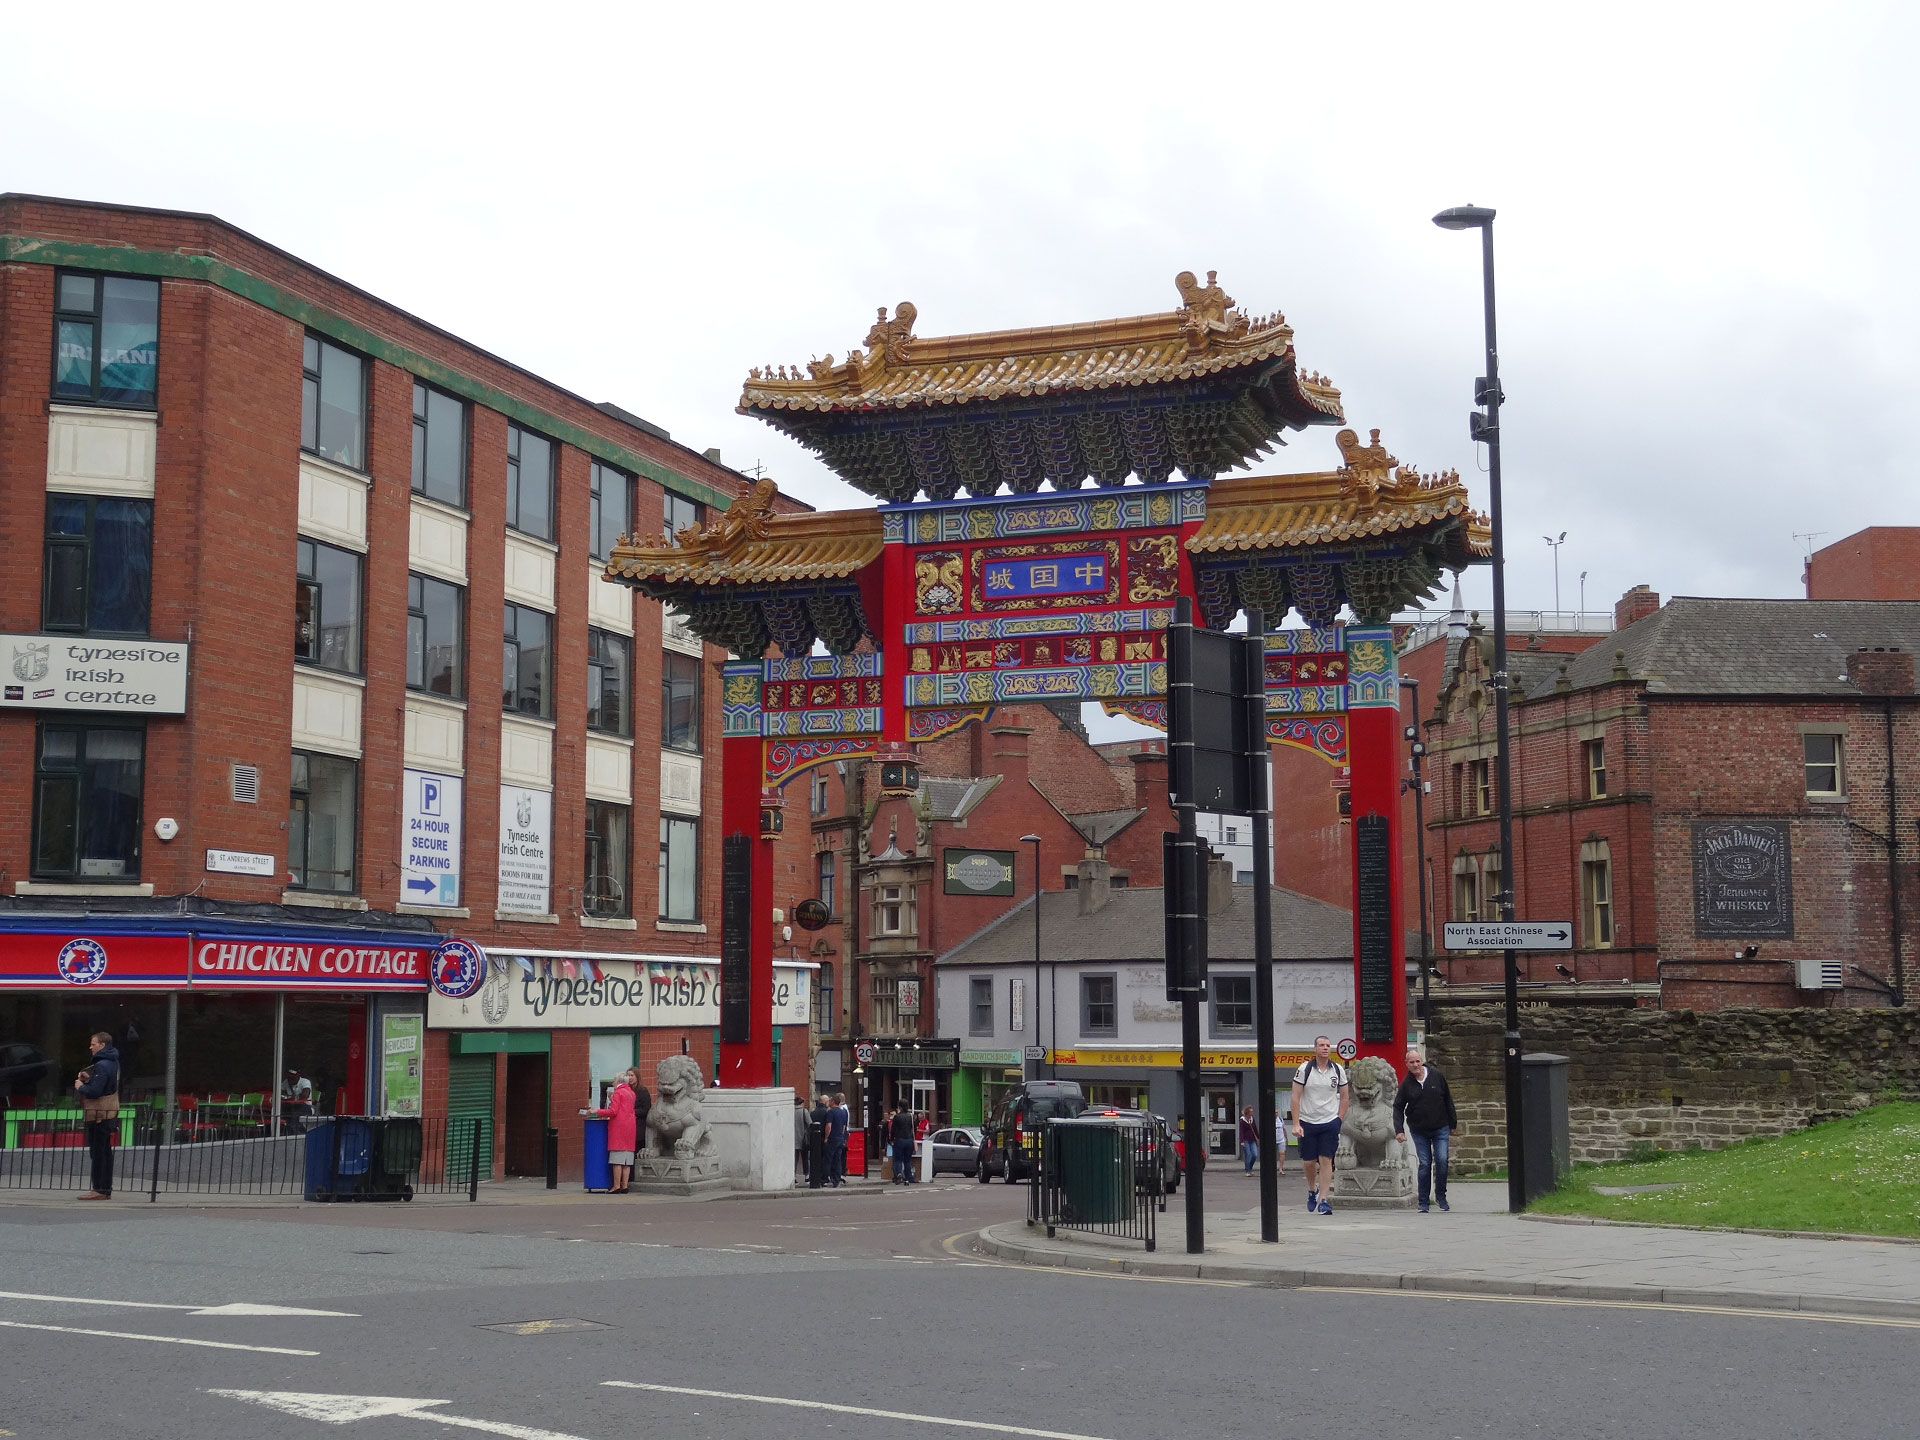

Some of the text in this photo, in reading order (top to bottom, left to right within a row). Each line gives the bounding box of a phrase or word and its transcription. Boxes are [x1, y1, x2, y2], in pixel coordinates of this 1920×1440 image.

[425, 784, 437, 810] P
[410, 818, 450, 834] 24 HOUR
[508, 829, 539, 843] Tyneside
[1706, 830, 1777, 855] JACK DANIEL'S
[412, 837, 448, 851] SECURE
[501, 843, 544, 858] Irish Centre
[227, 855, 250, 864] ANDREWS
[252, 856, 269, 865] STREET
[410, 854, 450, 869] PARKING
[502, 870, 520, 878] ROOMS
[1718, 884, 1768, 897] Tennessee
[1716, 901, 1771, 910] WHISKEY
[1447, 927, 1475, 935] North
[198, 943, 312, 972] CHICKEN
[858, 1048, 872, 1057] 20
[1340, 1045, 1355, 1054] 20
[874, 1052, 913, 1063] EWCASTLE
[1180, 1055, 1214, 1064] Cna
[1220, 1055, 1252, 1064] Town
